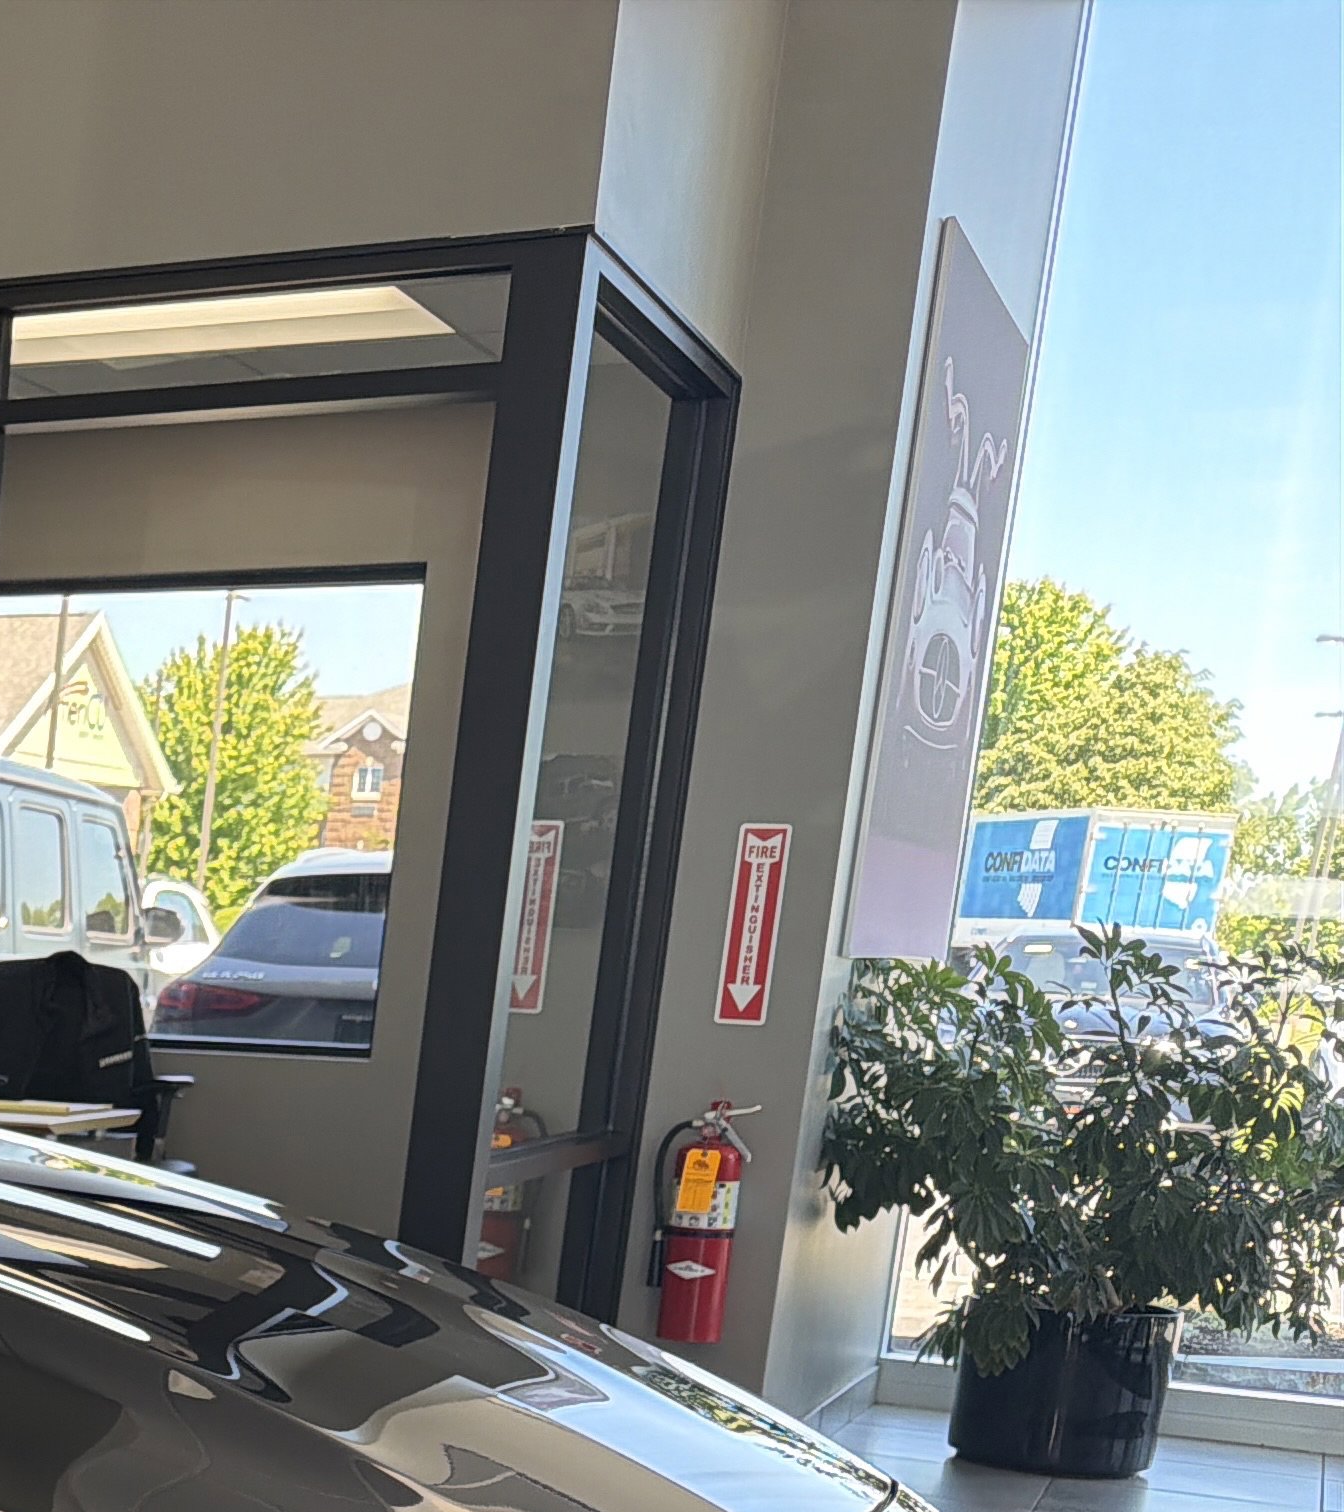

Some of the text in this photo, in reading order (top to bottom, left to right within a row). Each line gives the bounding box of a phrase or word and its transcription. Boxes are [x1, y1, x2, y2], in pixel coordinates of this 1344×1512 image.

[748, 845, 778, 860] FIRE
[984, 850, 1056, 873] CONFIDATA
[740, 863, 766, 986] EXTINGUISHER
